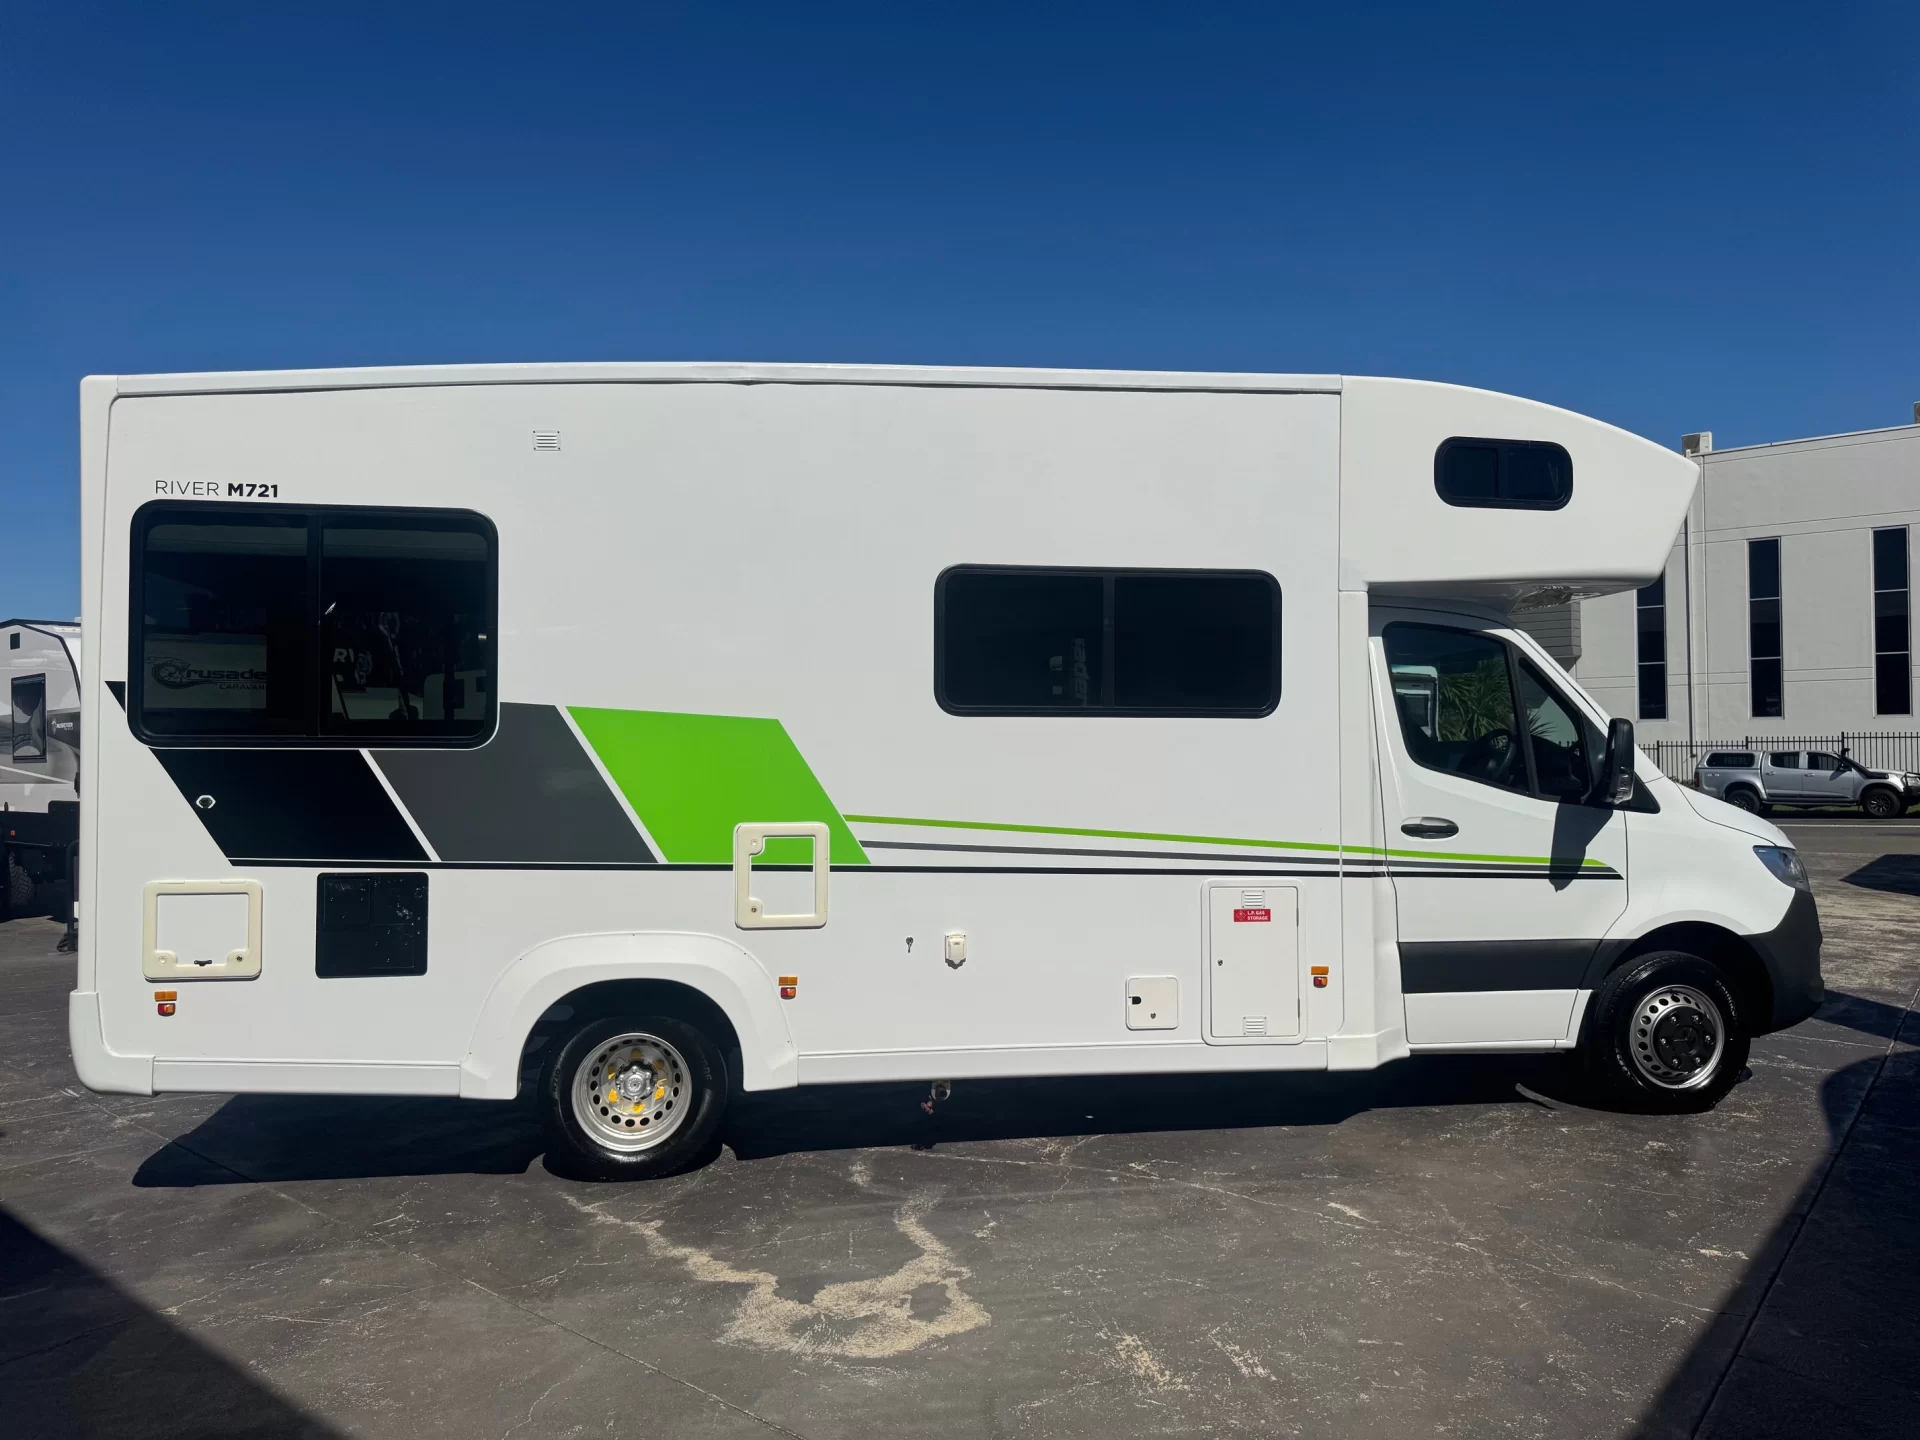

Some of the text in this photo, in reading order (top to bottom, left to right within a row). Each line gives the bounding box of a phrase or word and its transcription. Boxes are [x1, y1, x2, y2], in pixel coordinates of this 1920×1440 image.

[155, 480, 278, 498] RIVER M721
[151, 658, 268, 689] Crusade
[219, 683, 266, 691] CARAVAN
